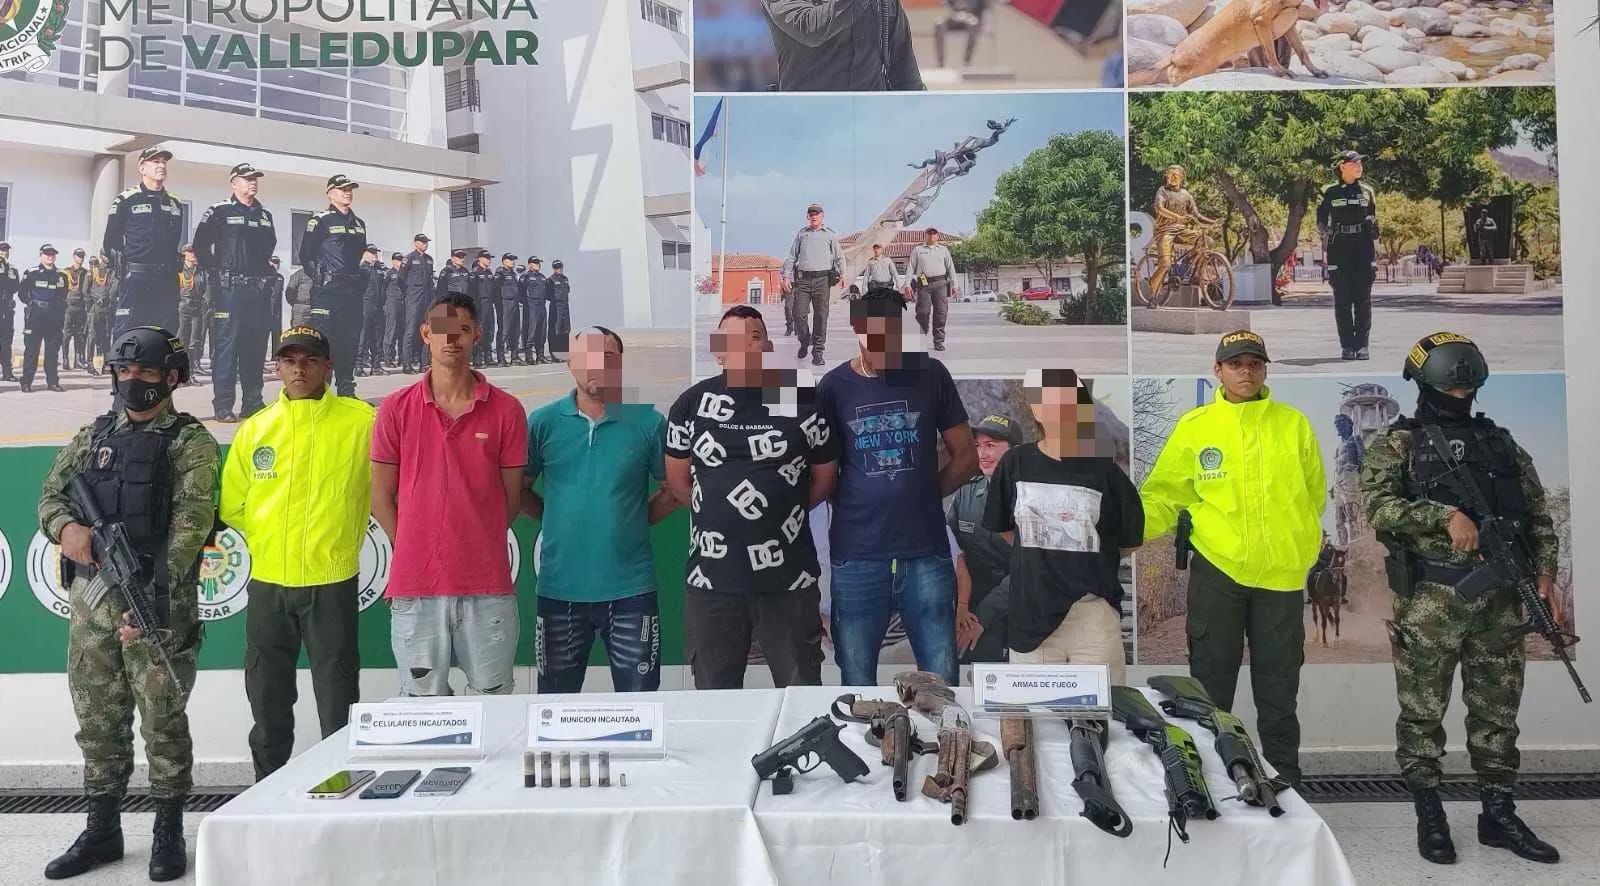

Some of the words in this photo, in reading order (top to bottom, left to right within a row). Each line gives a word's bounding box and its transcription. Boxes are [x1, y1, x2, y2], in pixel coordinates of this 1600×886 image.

[100, 0, 539, 25] METROPOLITANA
[0, 14, 46, 53] ACIONAL
[0, 51, 31, 69] TRIA
[101, 35, 168, 71] DE
[182, 30, 540, 69] VALLEDUPAR
[280, 327, 322, 343] POLICIA
[1223, 332, 1265, 347] POLICIA
[697, 392, 735, 422] DG
[748, 430, 788, 462] DG
[855, 433, 880, 450] NEW
[887, 429, 919, 445] YORK
[726, 478, 769, 520] DG
[700, 530, 728, 559] DG
[747, 540, 784, 571] DG
[198, 605, 231, 618] ESAR
[373, 719, 418, 728] CELULARES
[419, 718, 468, 727] INCAUTADOS
